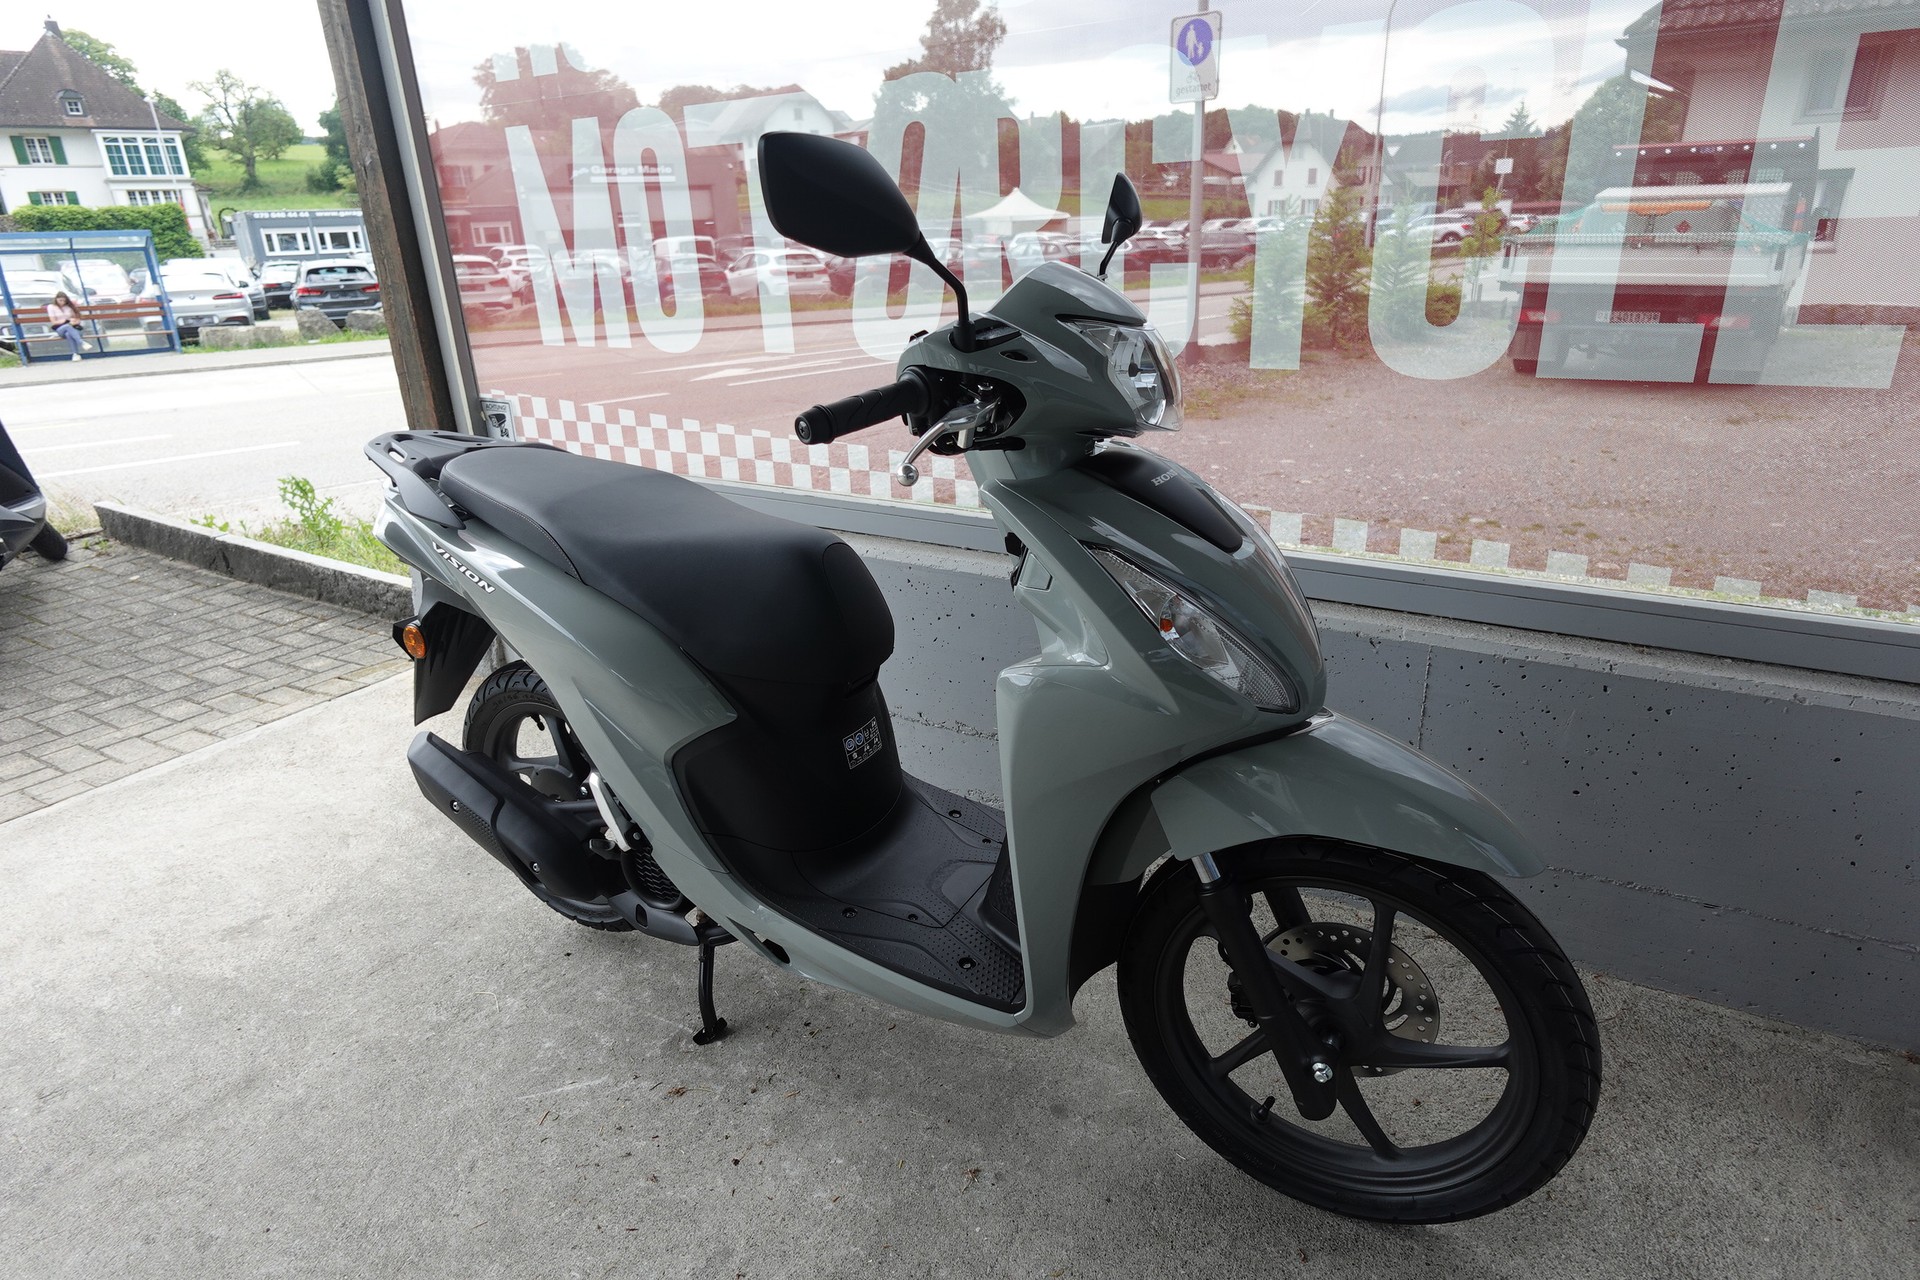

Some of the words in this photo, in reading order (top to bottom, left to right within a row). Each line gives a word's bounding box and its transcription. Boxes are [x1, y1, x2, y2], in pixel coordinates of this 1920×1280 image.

[1175, 82, 1212, 97] gestattet
[590, 165, 635, 175] Garage
[638, 165, 673, 174] Mario
[1151, 469, 1178, 486] HON
[432, 541, 496, 594] VISION
